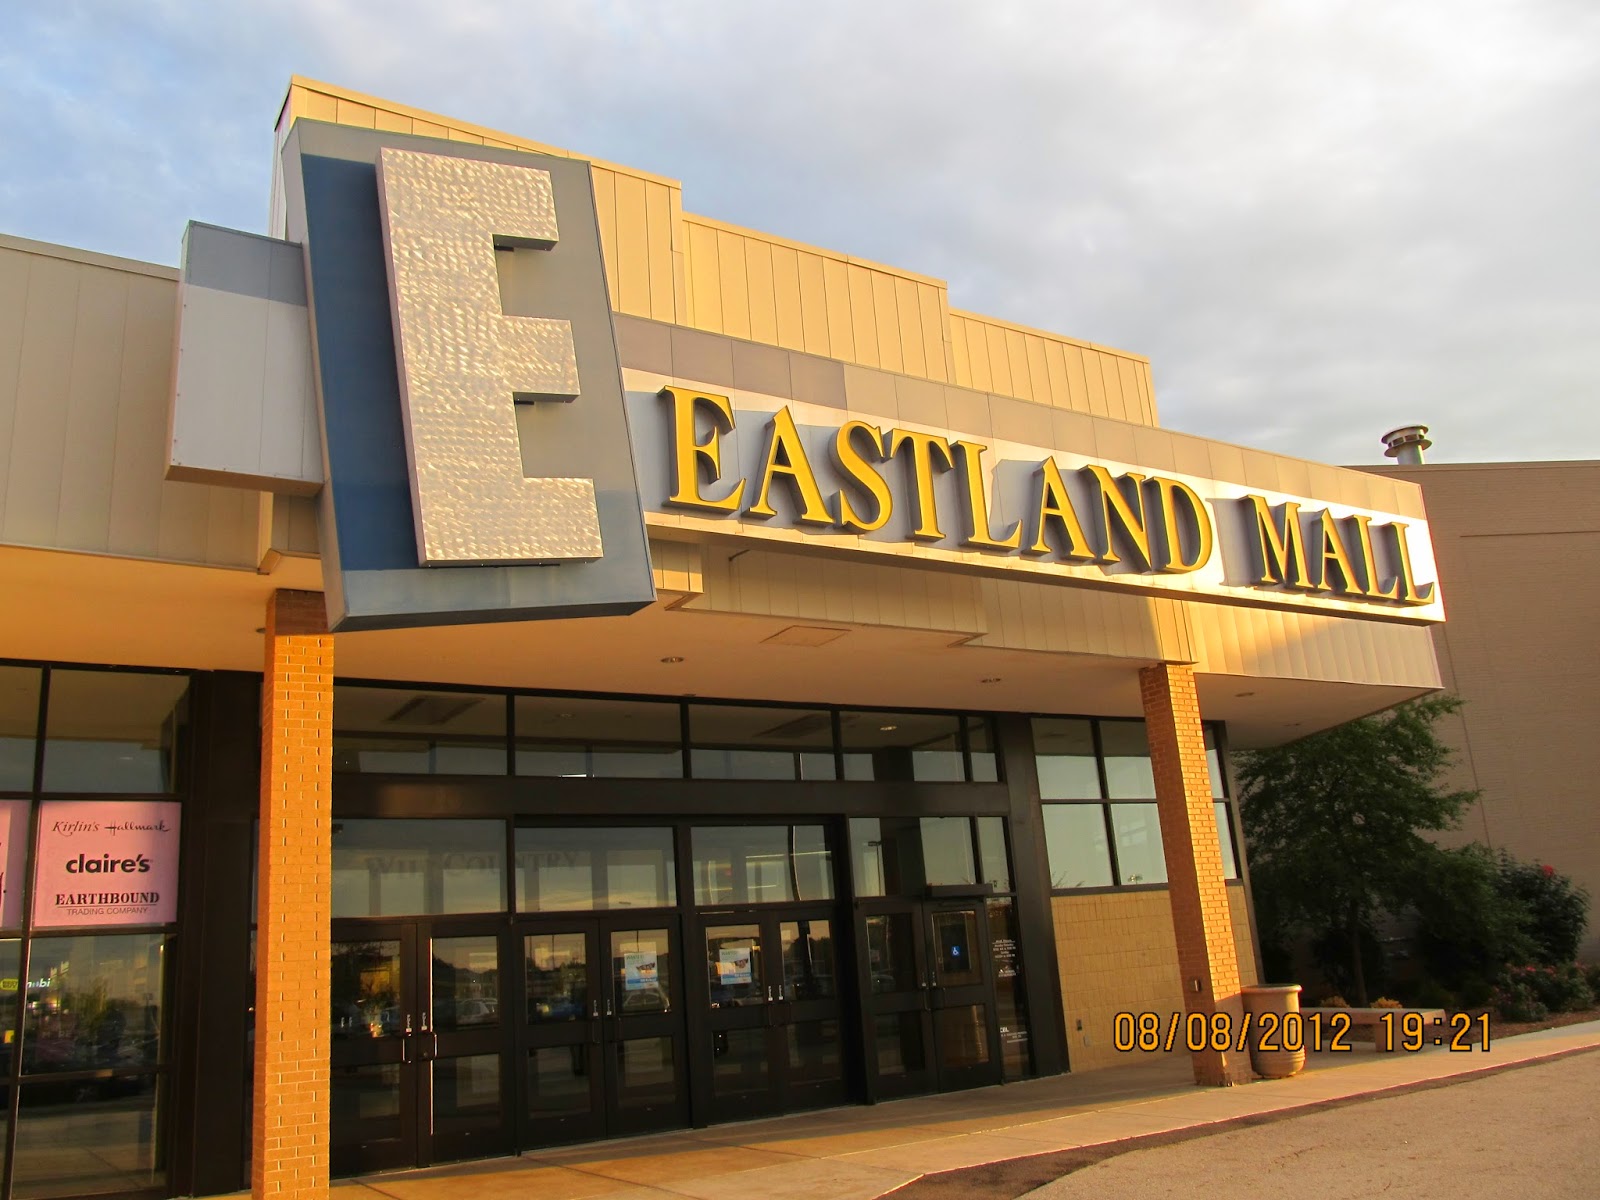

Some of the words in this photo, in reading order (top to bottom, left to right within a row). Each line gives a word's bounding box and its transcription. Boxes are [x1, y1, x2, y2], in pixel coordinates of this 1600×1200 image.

[374, 147, 604, 564] E
[658, 384, 1213, 575] EASTLAND
[1240, 494, 1435, 604] MALL
[52, 821, 100, 837] Kirlin's
[104, 820, 171, 836] Hallmark
[66, 853, 151, 873] claire's
[55, 892, 160, 905] EARTHBOUND
[67, 908, 105, 916] TRADING
[107, 907, 148, 915] COMPANY
